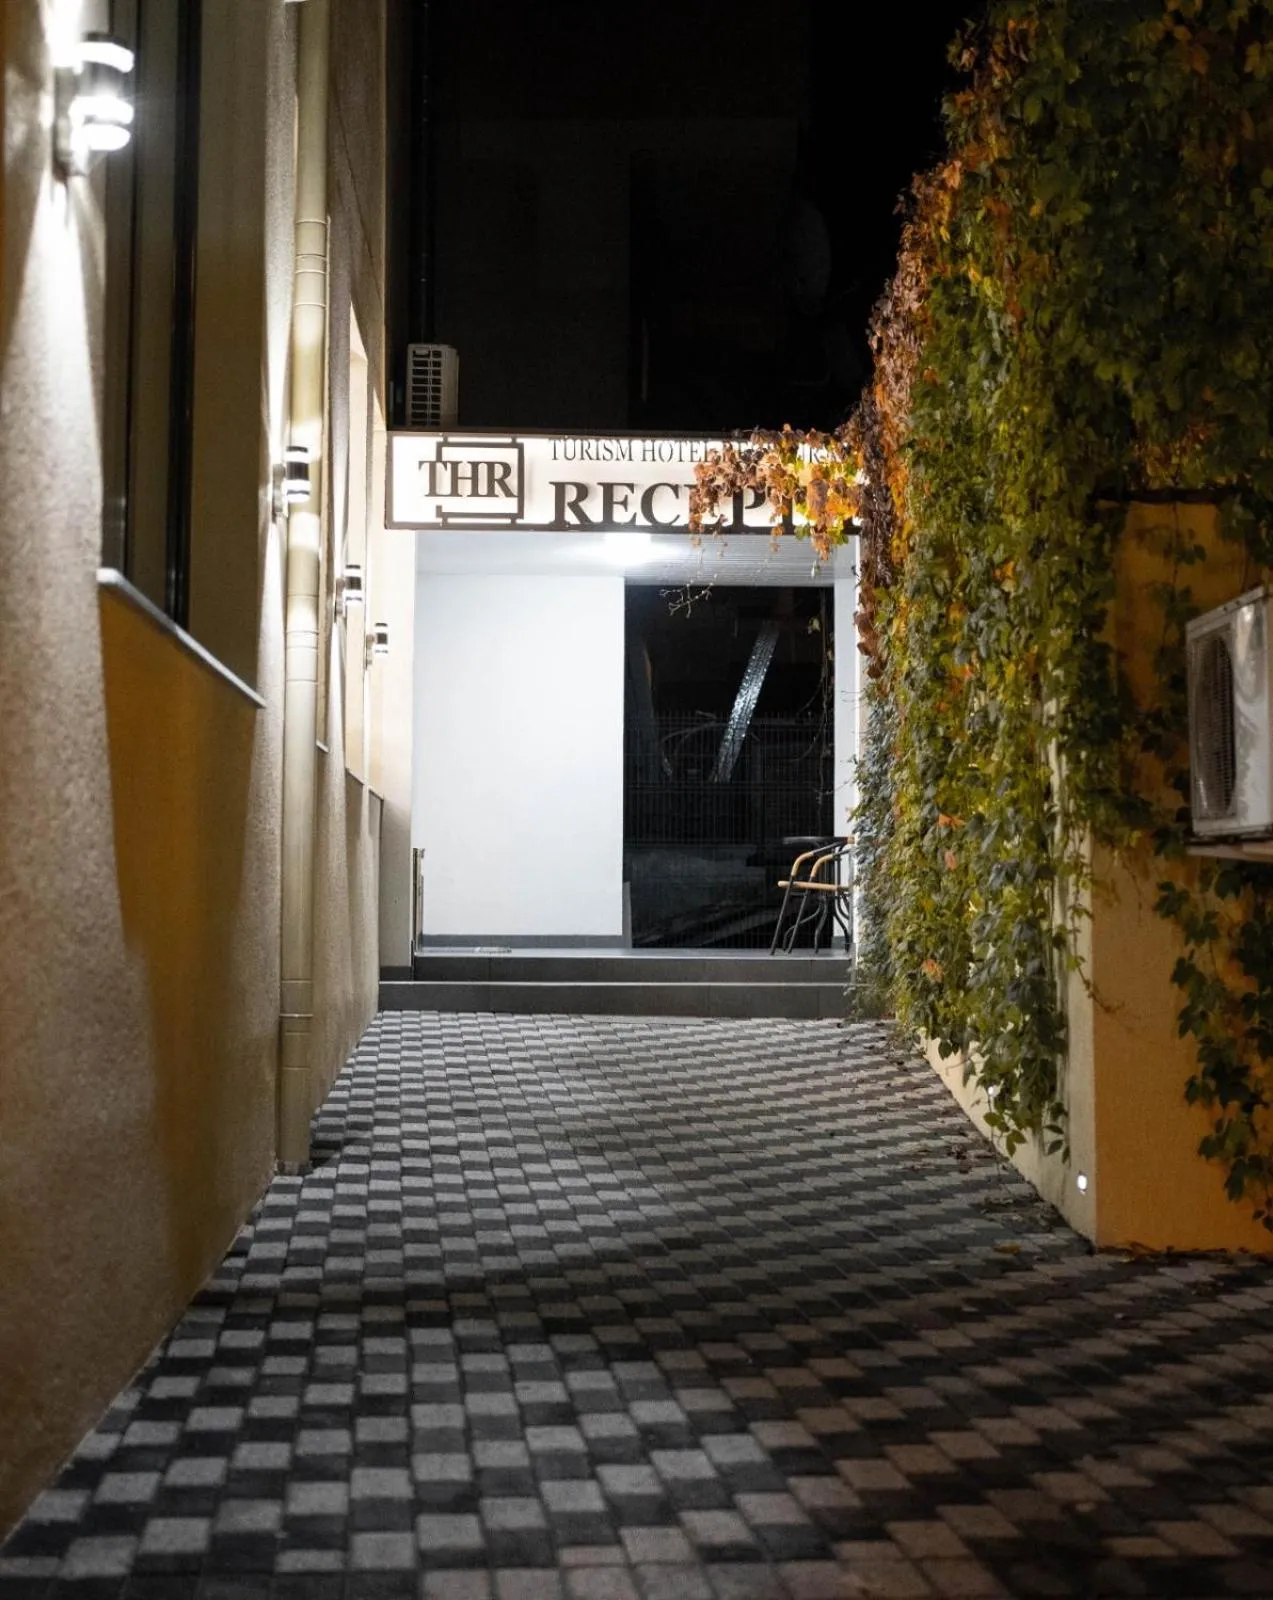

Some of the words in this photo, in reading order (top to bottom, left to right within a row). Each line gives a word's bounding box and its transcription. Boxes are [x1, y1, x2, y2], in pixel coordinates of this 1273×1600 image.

[548, 439, 633, 462] TURISM
[641, 440, 713, 463] HOTEL
[418, 460, 518, 498] THR
